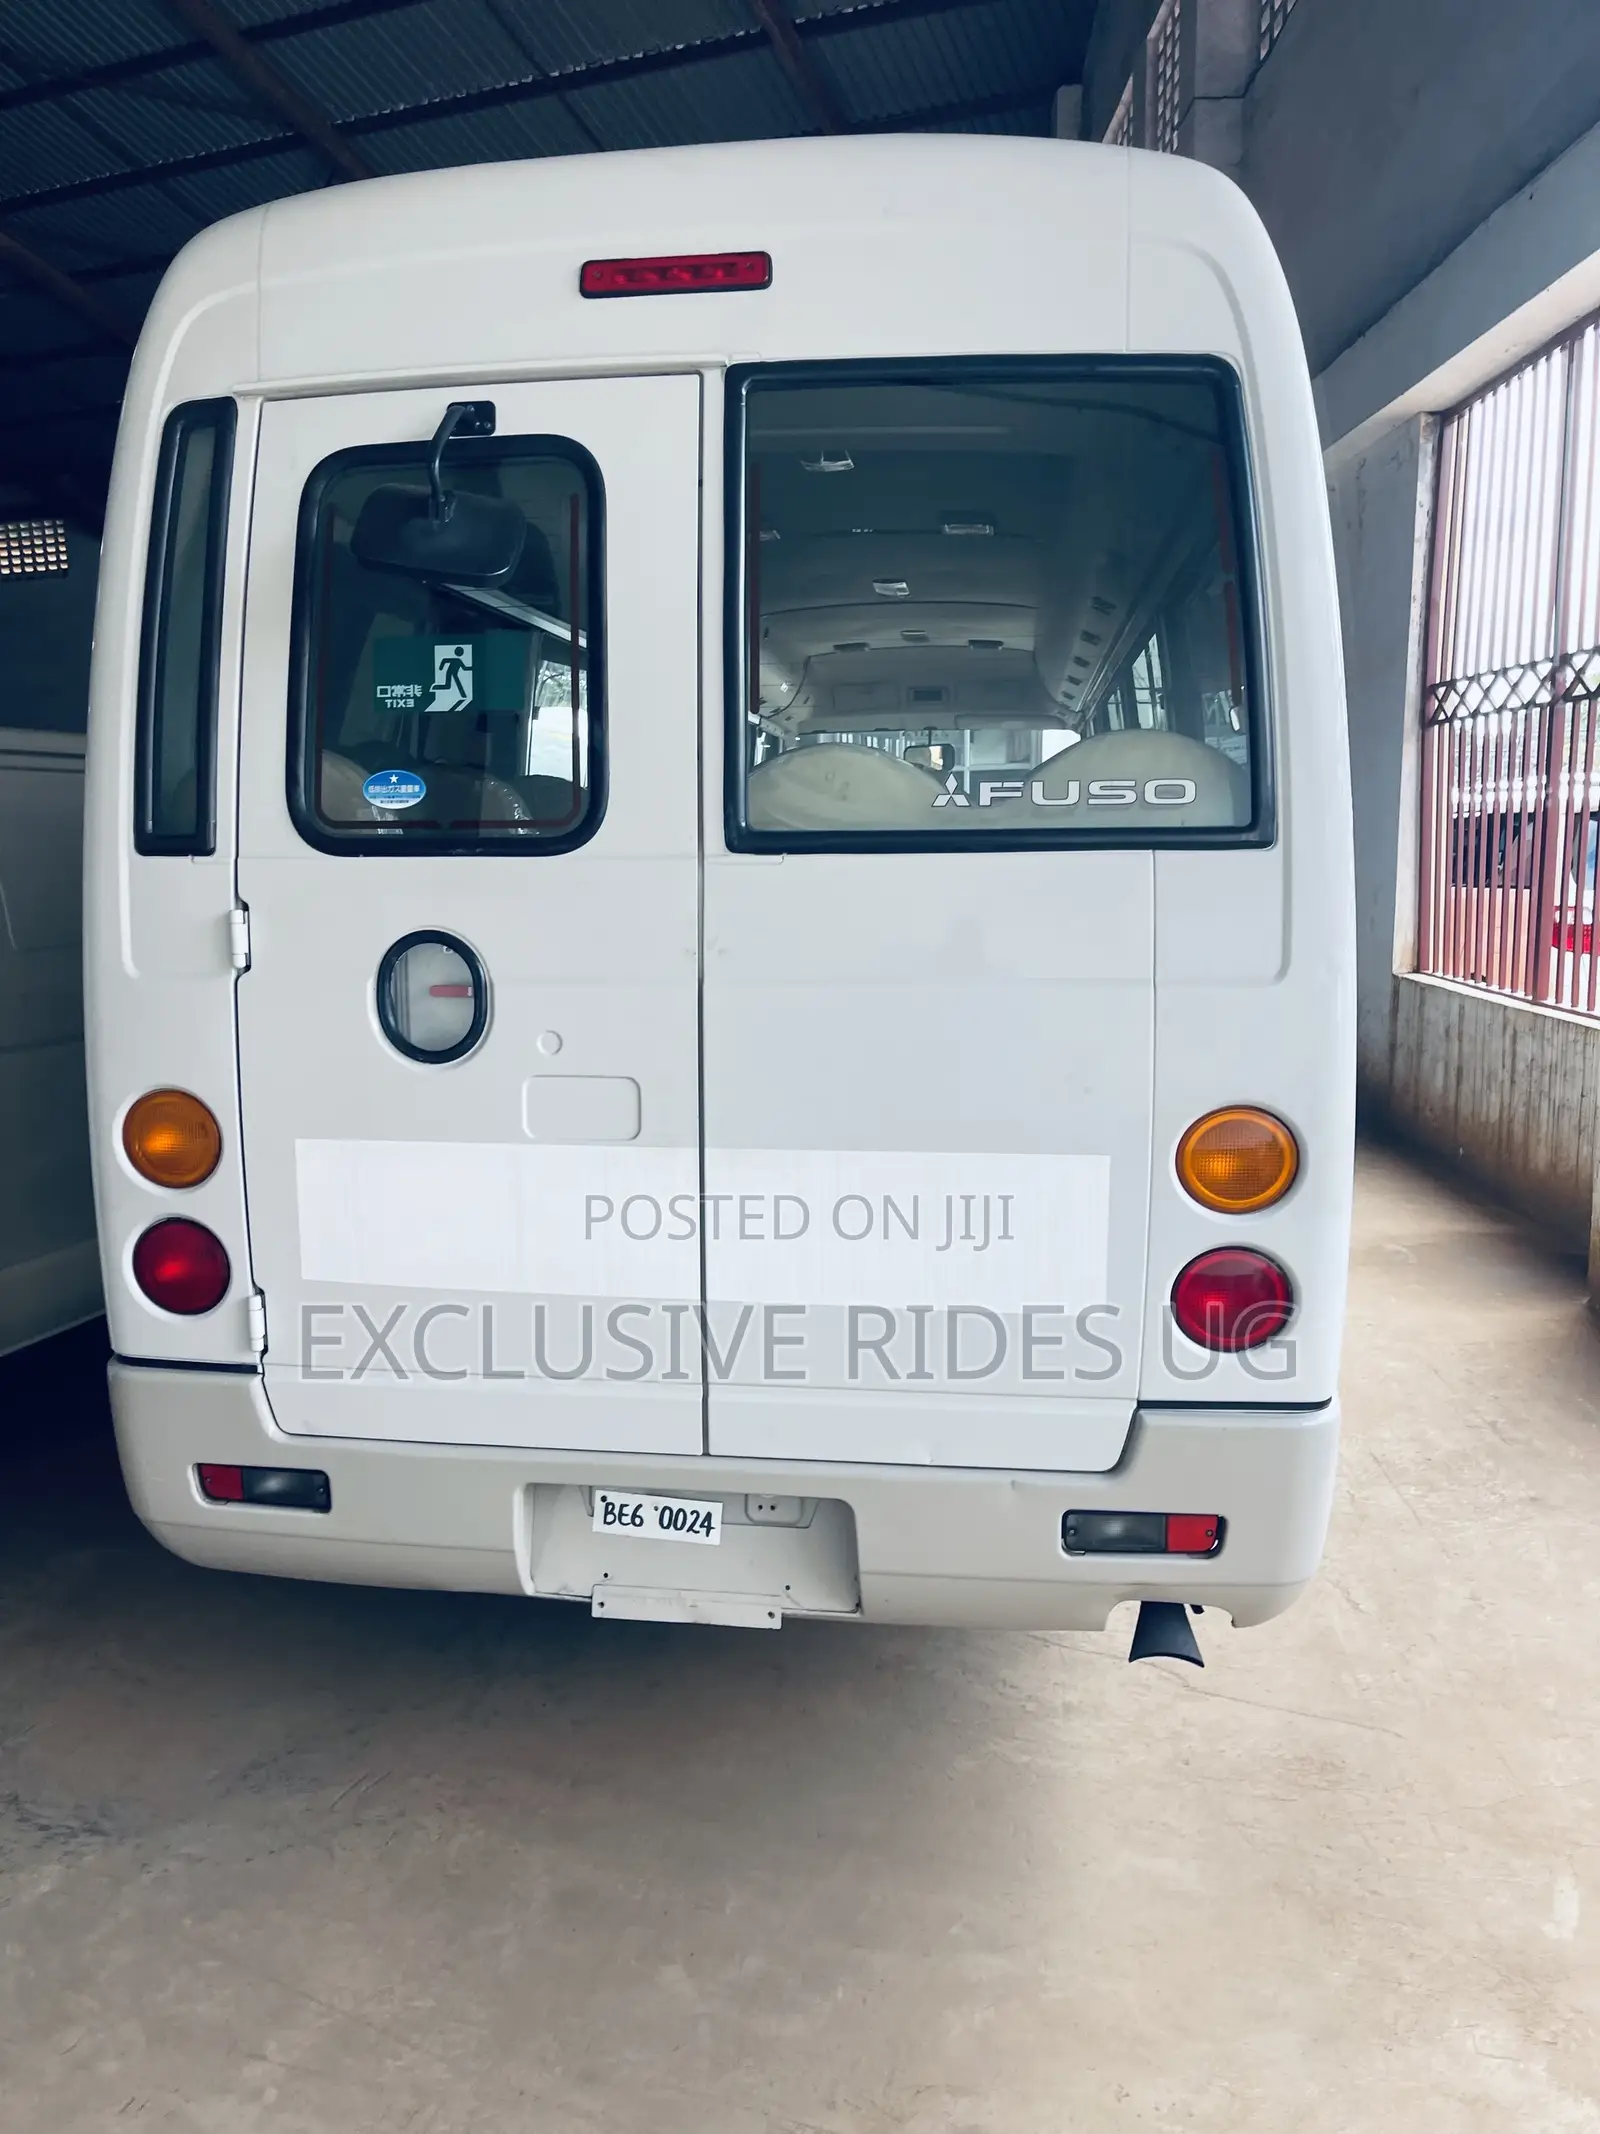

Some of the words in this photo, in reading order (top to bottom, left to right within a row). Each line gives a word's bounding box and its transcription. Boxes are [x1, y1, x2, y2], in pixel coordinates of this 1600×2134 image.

[978, 778, 1197, 806] FUSO
[603, 1502, 645, 1528] BE6
[658, 1506, 716, 1538] 0024
